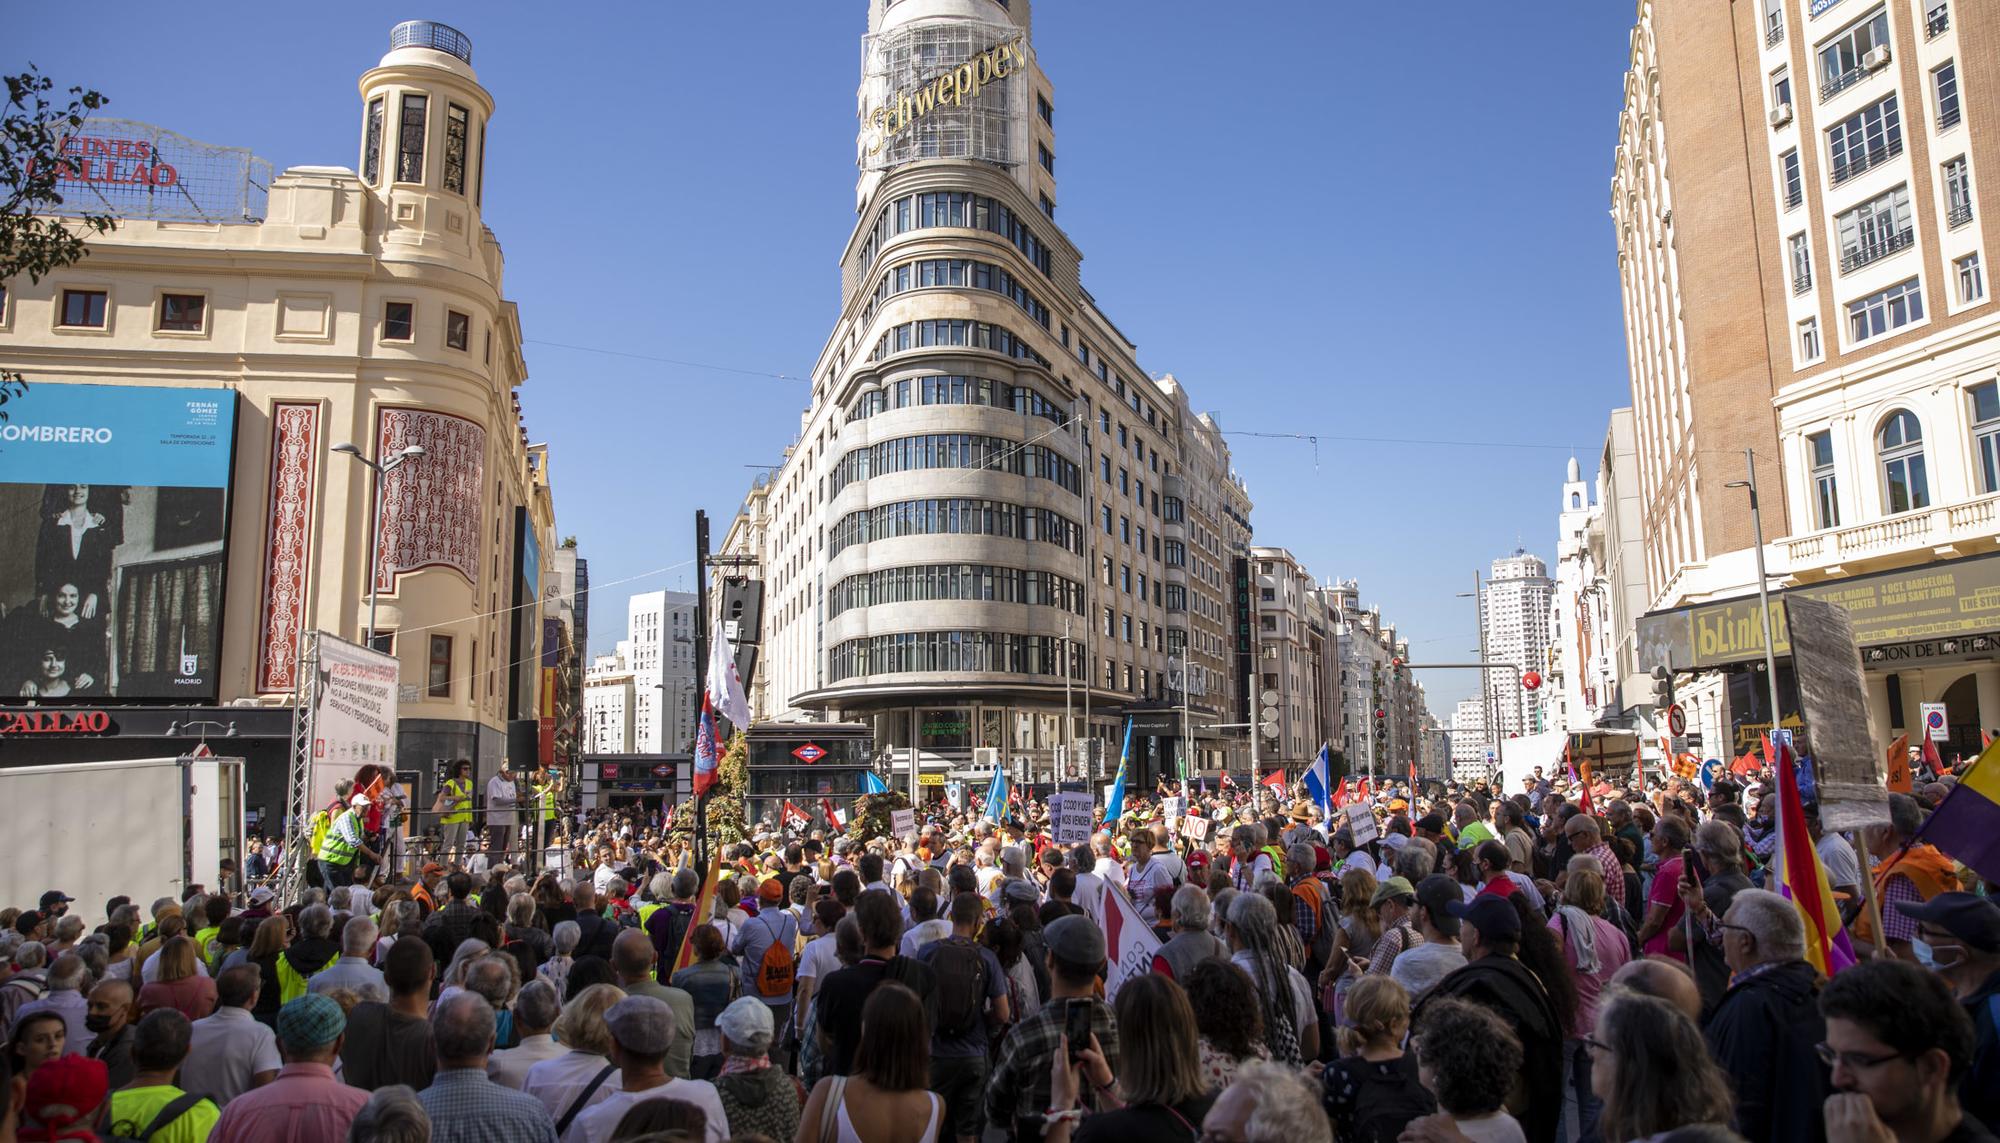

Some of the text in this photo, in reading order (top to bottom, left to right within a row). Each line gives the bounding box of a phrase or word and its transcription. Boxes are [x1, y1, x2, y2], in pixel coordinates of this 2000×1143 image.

[868, 35, 1025, 157] Schweppes
[60, 137, 150, 160] CINES
[26, 157, 177, 187] CALLAO
[1906, 573, 1954, 591] BARCELONA
[1238, 577, 1249, 651] HOTEL
[1915, 643, 1935, 658] DE
[0, 711, 110, 733] CALLAO
[1062, 814, 1071, 825] NOS
[1184, 817, 1206, 838] NO
